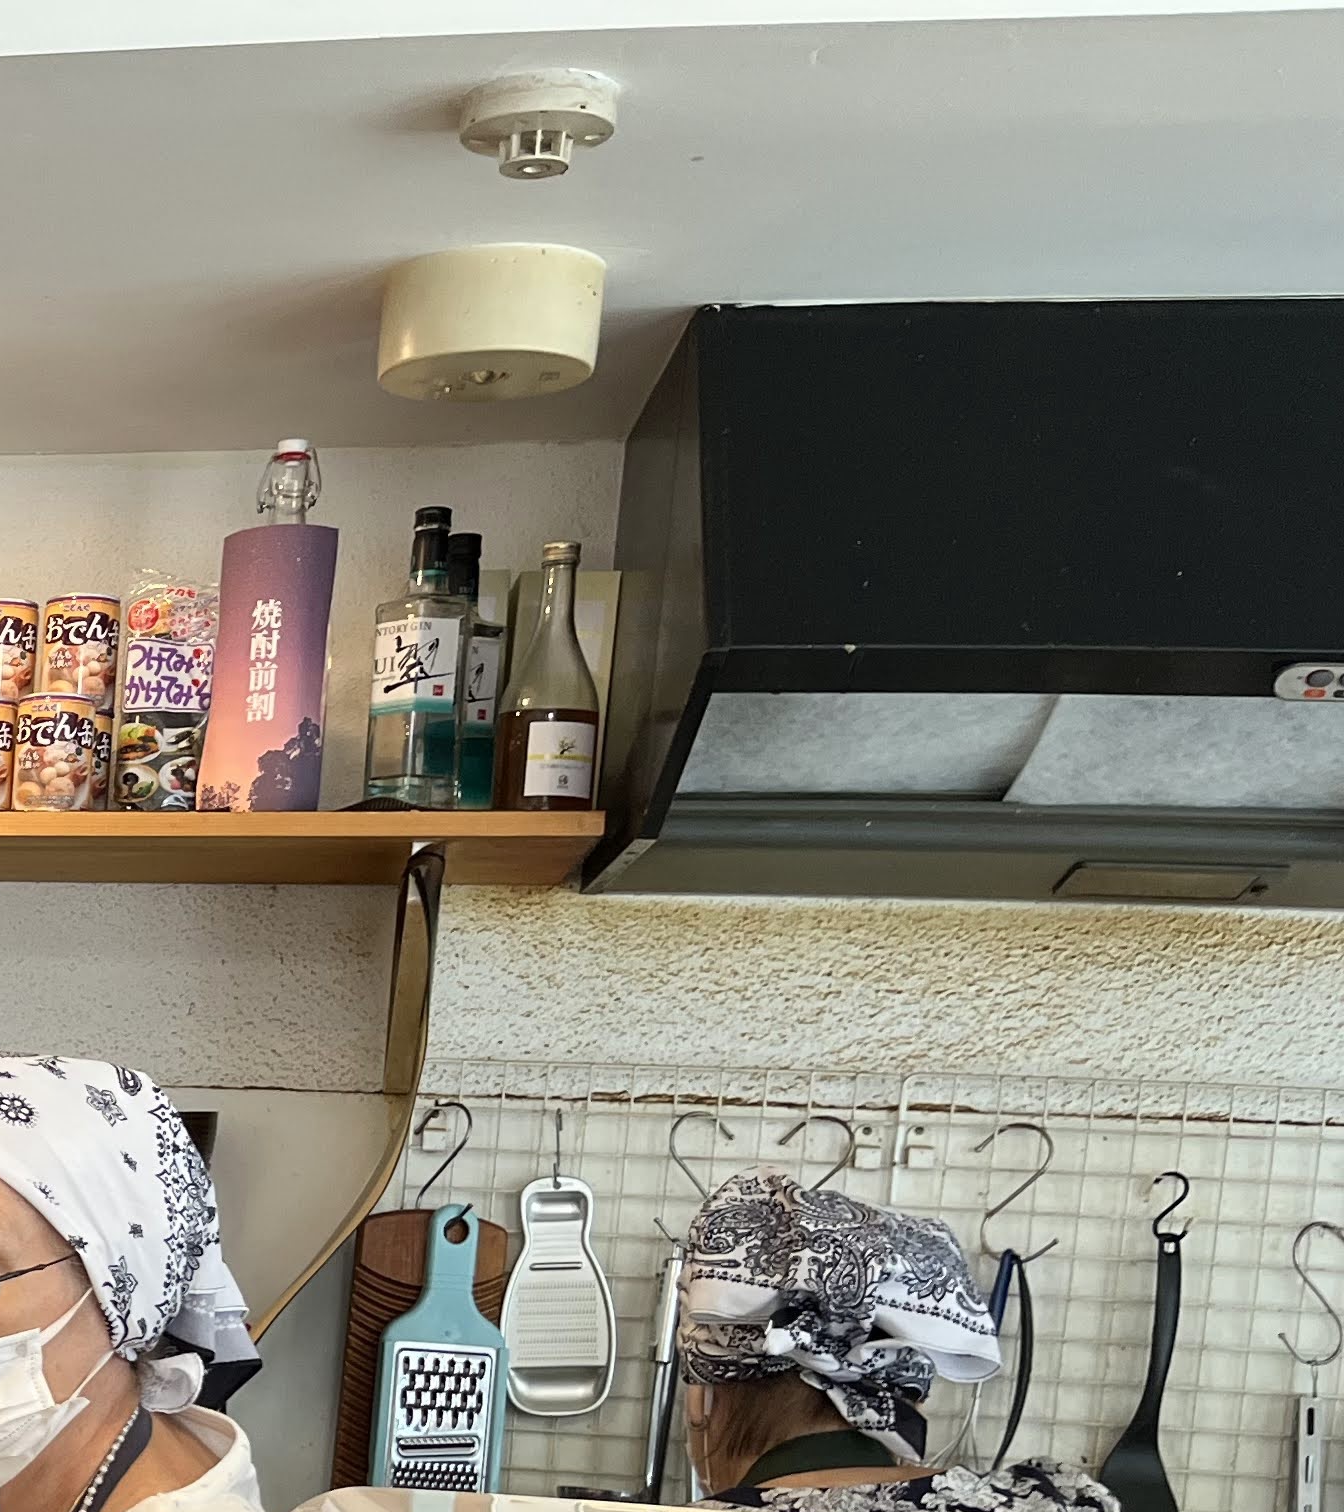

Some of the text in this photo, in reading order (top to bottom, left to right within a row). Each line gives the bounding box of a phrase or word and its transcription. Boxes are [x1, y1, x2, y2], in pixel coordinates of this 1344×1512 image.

[45, 611, 120, 647] おでん缶
[409, 621, 432, 631] GIN
[245, 598, 283, 723] 焼酎前割
[16, 712, 94, 749] おでん缶
